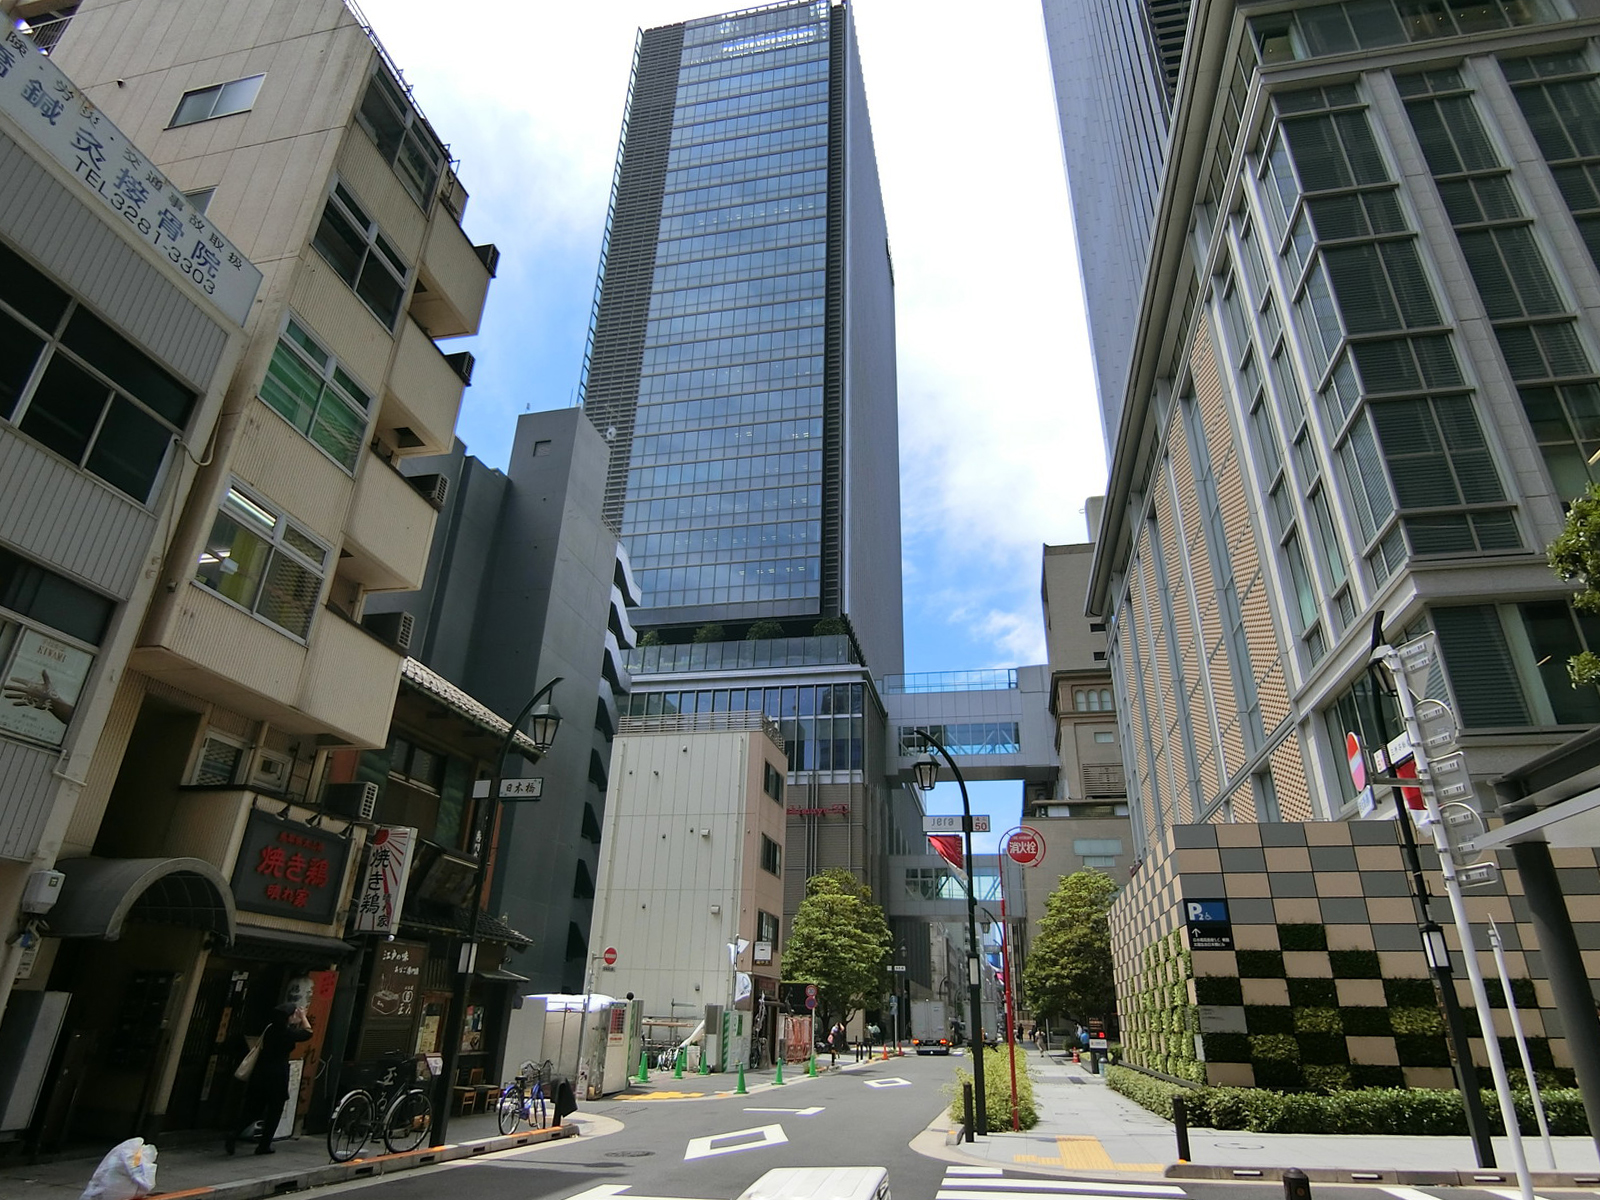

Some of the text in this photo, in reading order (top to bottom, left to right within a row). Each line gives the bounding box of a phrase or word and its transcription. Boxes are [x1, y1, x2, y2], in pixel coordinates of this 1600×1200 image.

[506, 783, 536, 794] 日本橋
[1009, 841, 1037, 854] 消火栓
[257, 846, 329, 887] 焼き鶏
[361, 848, 391, 914] 焼き鶏
[382, 949, 410, 962] 江戸の味
